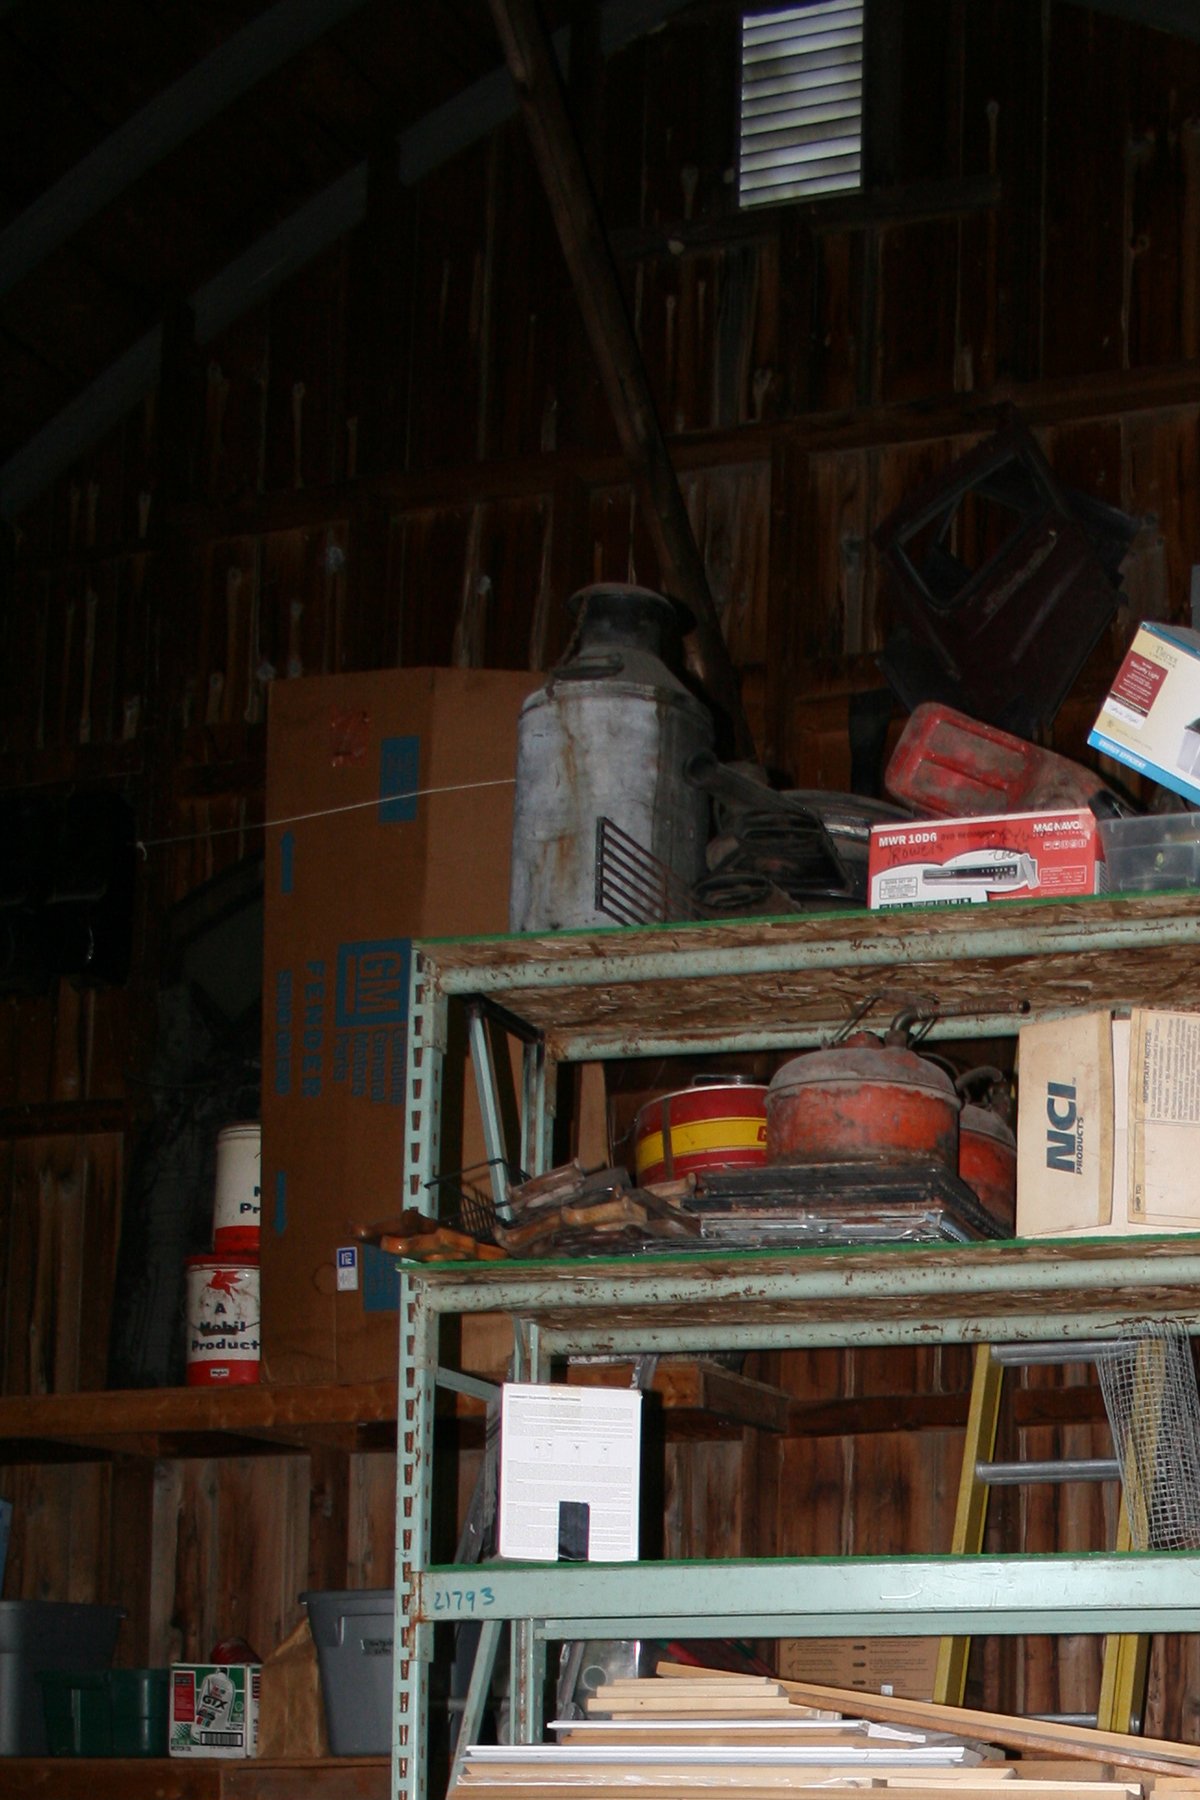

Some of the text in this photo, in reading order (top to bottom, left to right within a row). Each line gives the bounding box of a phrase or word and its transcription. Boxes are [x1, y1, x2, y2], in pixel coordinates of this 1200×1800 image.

[879, 832, 937, 848] MWR 10D6
[1033, 820, 1092, 832] MAGNAVO
[359, 951, 403, 1015] GM
[303, 960, 326, 1097] FENDER
[334, 1034, 349, 1082] Parts
[352, 1031, 368, 1097] Motors
[371, 1031, 388, 1104] General
[1046, 1081, 1077, 1174] NCI
[1076, 1116, 1084, 1175] PRODUCTS
[200, 1321, 246, 1334] Mobil
[214, 1303, 227, 1315] A
[191, 1340, 260, 1351] Product
[434, 1586, 496, 1612] 21793
[202, 1695, 228, 1710] GTX
